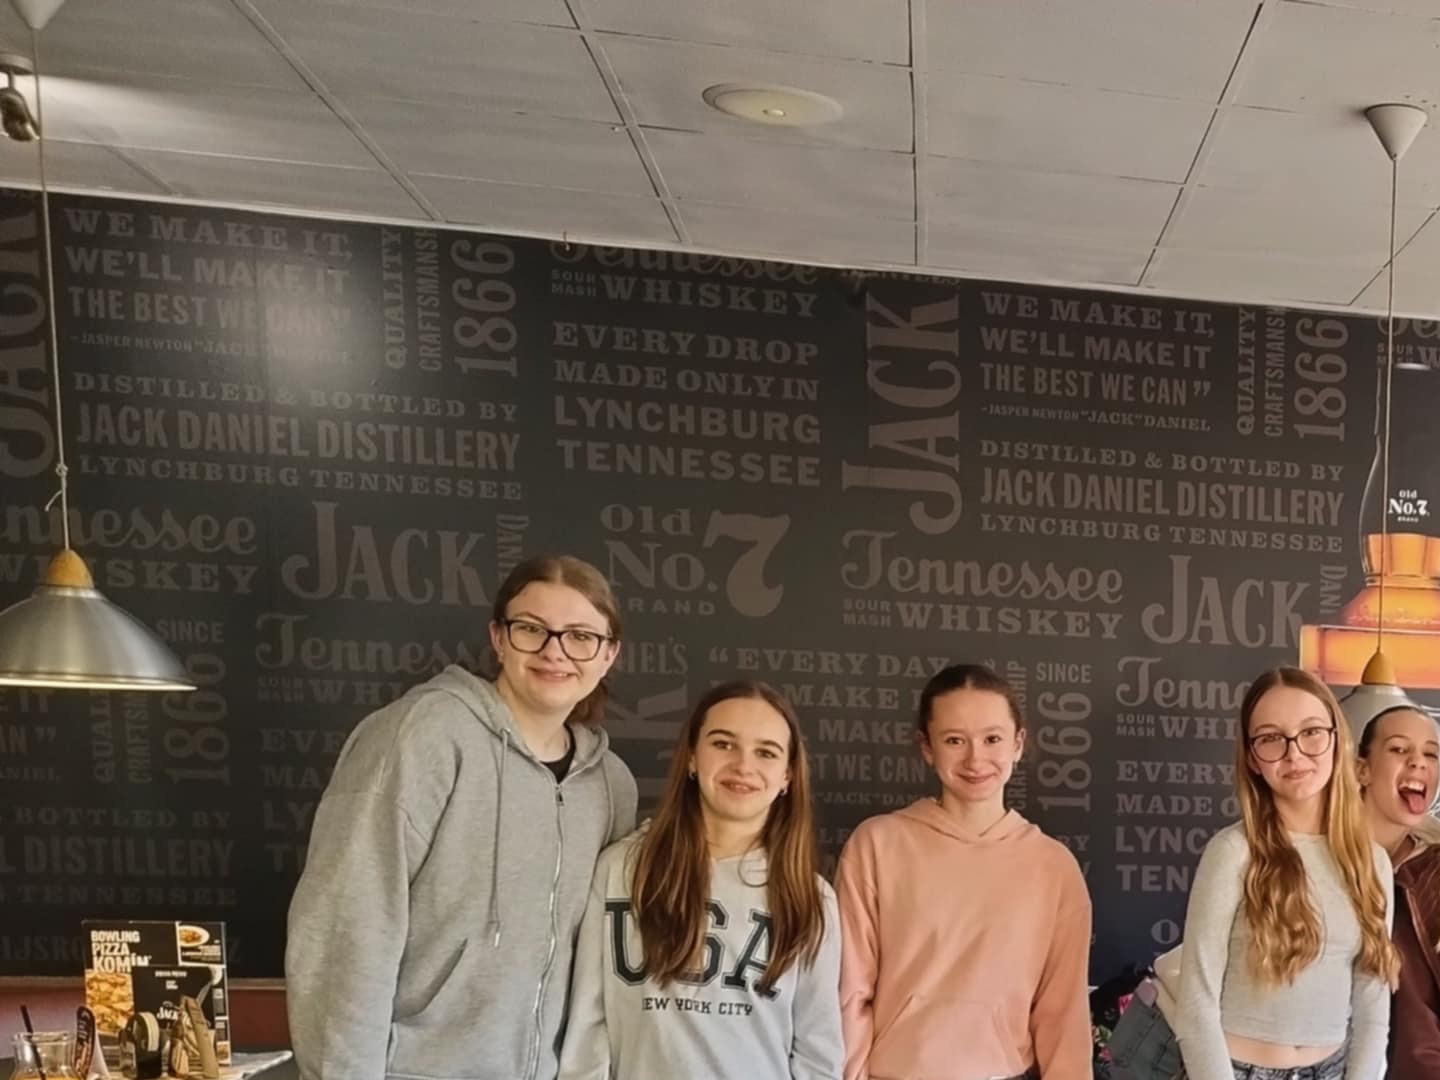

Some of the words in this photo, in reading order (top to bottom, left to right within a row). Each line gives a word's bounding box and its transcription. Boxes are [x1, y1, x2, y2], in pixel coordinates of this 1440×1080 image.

[63, 207, 136, 238] WE
[149, 214, 289, 251] MAKE
[302, 231, 352, 264] IT,
[192, 256, 304, 298] MAKE
[312, 263, 350, 297] IT
[551, 268, 597, 283] SOUR
[551, 283, 597, 297] MASH
[600, 274, 818, 318] WHISKEY
[66, 286, 125, 321] THE
[133, 290, 208, 327] BEST
[216, 297, 257, 330] WE
[381, 227, 408, 369] QUALITY
[451, 238, 519, 379] 1866
[979, 290, 1040, 320] WE
[1050, 298, 1164, 330] MAKE
[1173, 309, 1216, 338] IT,
[552, 319, 697, 357] EVERY
[705, 333, 820, 366] DROP
[1083, 334, 1175, 368] MAKE
[1182, 343, 1213, 370] IT
[552, 359, 668, 391] MADE
[675, 368, 777, 399] ONLY
[780, 376, 821, 402] IN
[979, 362, 1027, 394] THE
[1032, 366, 1095, 400] BEST
[1100, 371, 1136, 402] WE
[1235, 306, 1257, 437] QUALITY
[1293, 316, 1350, 443] 1866
[72, 371, 266, 404] DISTILLED
[277, 386, 298, 406] &
[309, 389, 465, 418] BOTTLED
[478, 401, 519, 423] BY
[841, 290, 964, 535] JACK
[76, 402, 169, 449] JACK
[176, 409, 311, 457] DANIEL
[316, 418, 521, 473] DISTILLERY
[553, 394, 822, 445] LYNCHBURG
[1031, 407, 1081, 423] NEWTON
[1143, 414, 1213, 434] DANIEL
[79, 454, 300, 488] LYNCHBURG
[309, 468, 523, 501] TENNESSEE
[555, 437, 822, 488] TENNESSEE
[979, 439, 1138, 469] DISTILLED
[1143, 450, 1163, 470] &
[1171, 453, 1301, 479] BOTTLED
[1310, 463, 1345, 483] BY
[979, 466, 1057, 509] JACK
[1062, 472, 1171, 516] DANIEL
[1176, 479, 1346, 528] DISTILLERY
[1397, 489, 1418, 500] Old
[599, 502, 696, 537] Old
[979, 513, 1162, 543] LYNCHBURG
[1168, 526, 1344, 554] TENNESSEE
[281, 499, 495, 608] JACK
[603, 539, 719, 593] No.
[702, 508, 793, 617] 7
[840, 528, 1124, 604] Tennessee
[627, 597, 717, 616] RAND
[842, 613, 892, 627] MASH
[843, 599, 892, 613] SOUR
[896, 601, 1118, 640] WHISKEY
[1140, 554, 1312, 648] JACK
[155, 616, 225, 644] SINCE
[878, 656, 951, 680] DAY
[1035, 661, 1093, 685] SINCE
[784, 682, 900, 712] MAKE
[161, 652, 232, 786] 1866
[817, 717, 913, 746] MAKE
[1116, 712, 1155, 725] SOUR
[1116, 725, 1155, 737] MASH
[835, 752, 873, 783] WE
[1036, 691, 1093, 813] 1866
[1115, 759, 1237, 785] EVERY
[15, 806, 177, 828] BOTTLED
[191, 810, 232, 829] BY
[1115, 792, 1213, 816] MADE
[23, 834, 235, 878] DISTILLERY
[16, 882, 238, 907] TENNESSEE
[90, 930, 141, 944] BOWLING
[91, 942, 130, 956] PIZZA
[642, 997, 670, 1012] EW
[674, 998, 712, 1015] YORK
[718, 1001, 753, 1017] CITY
